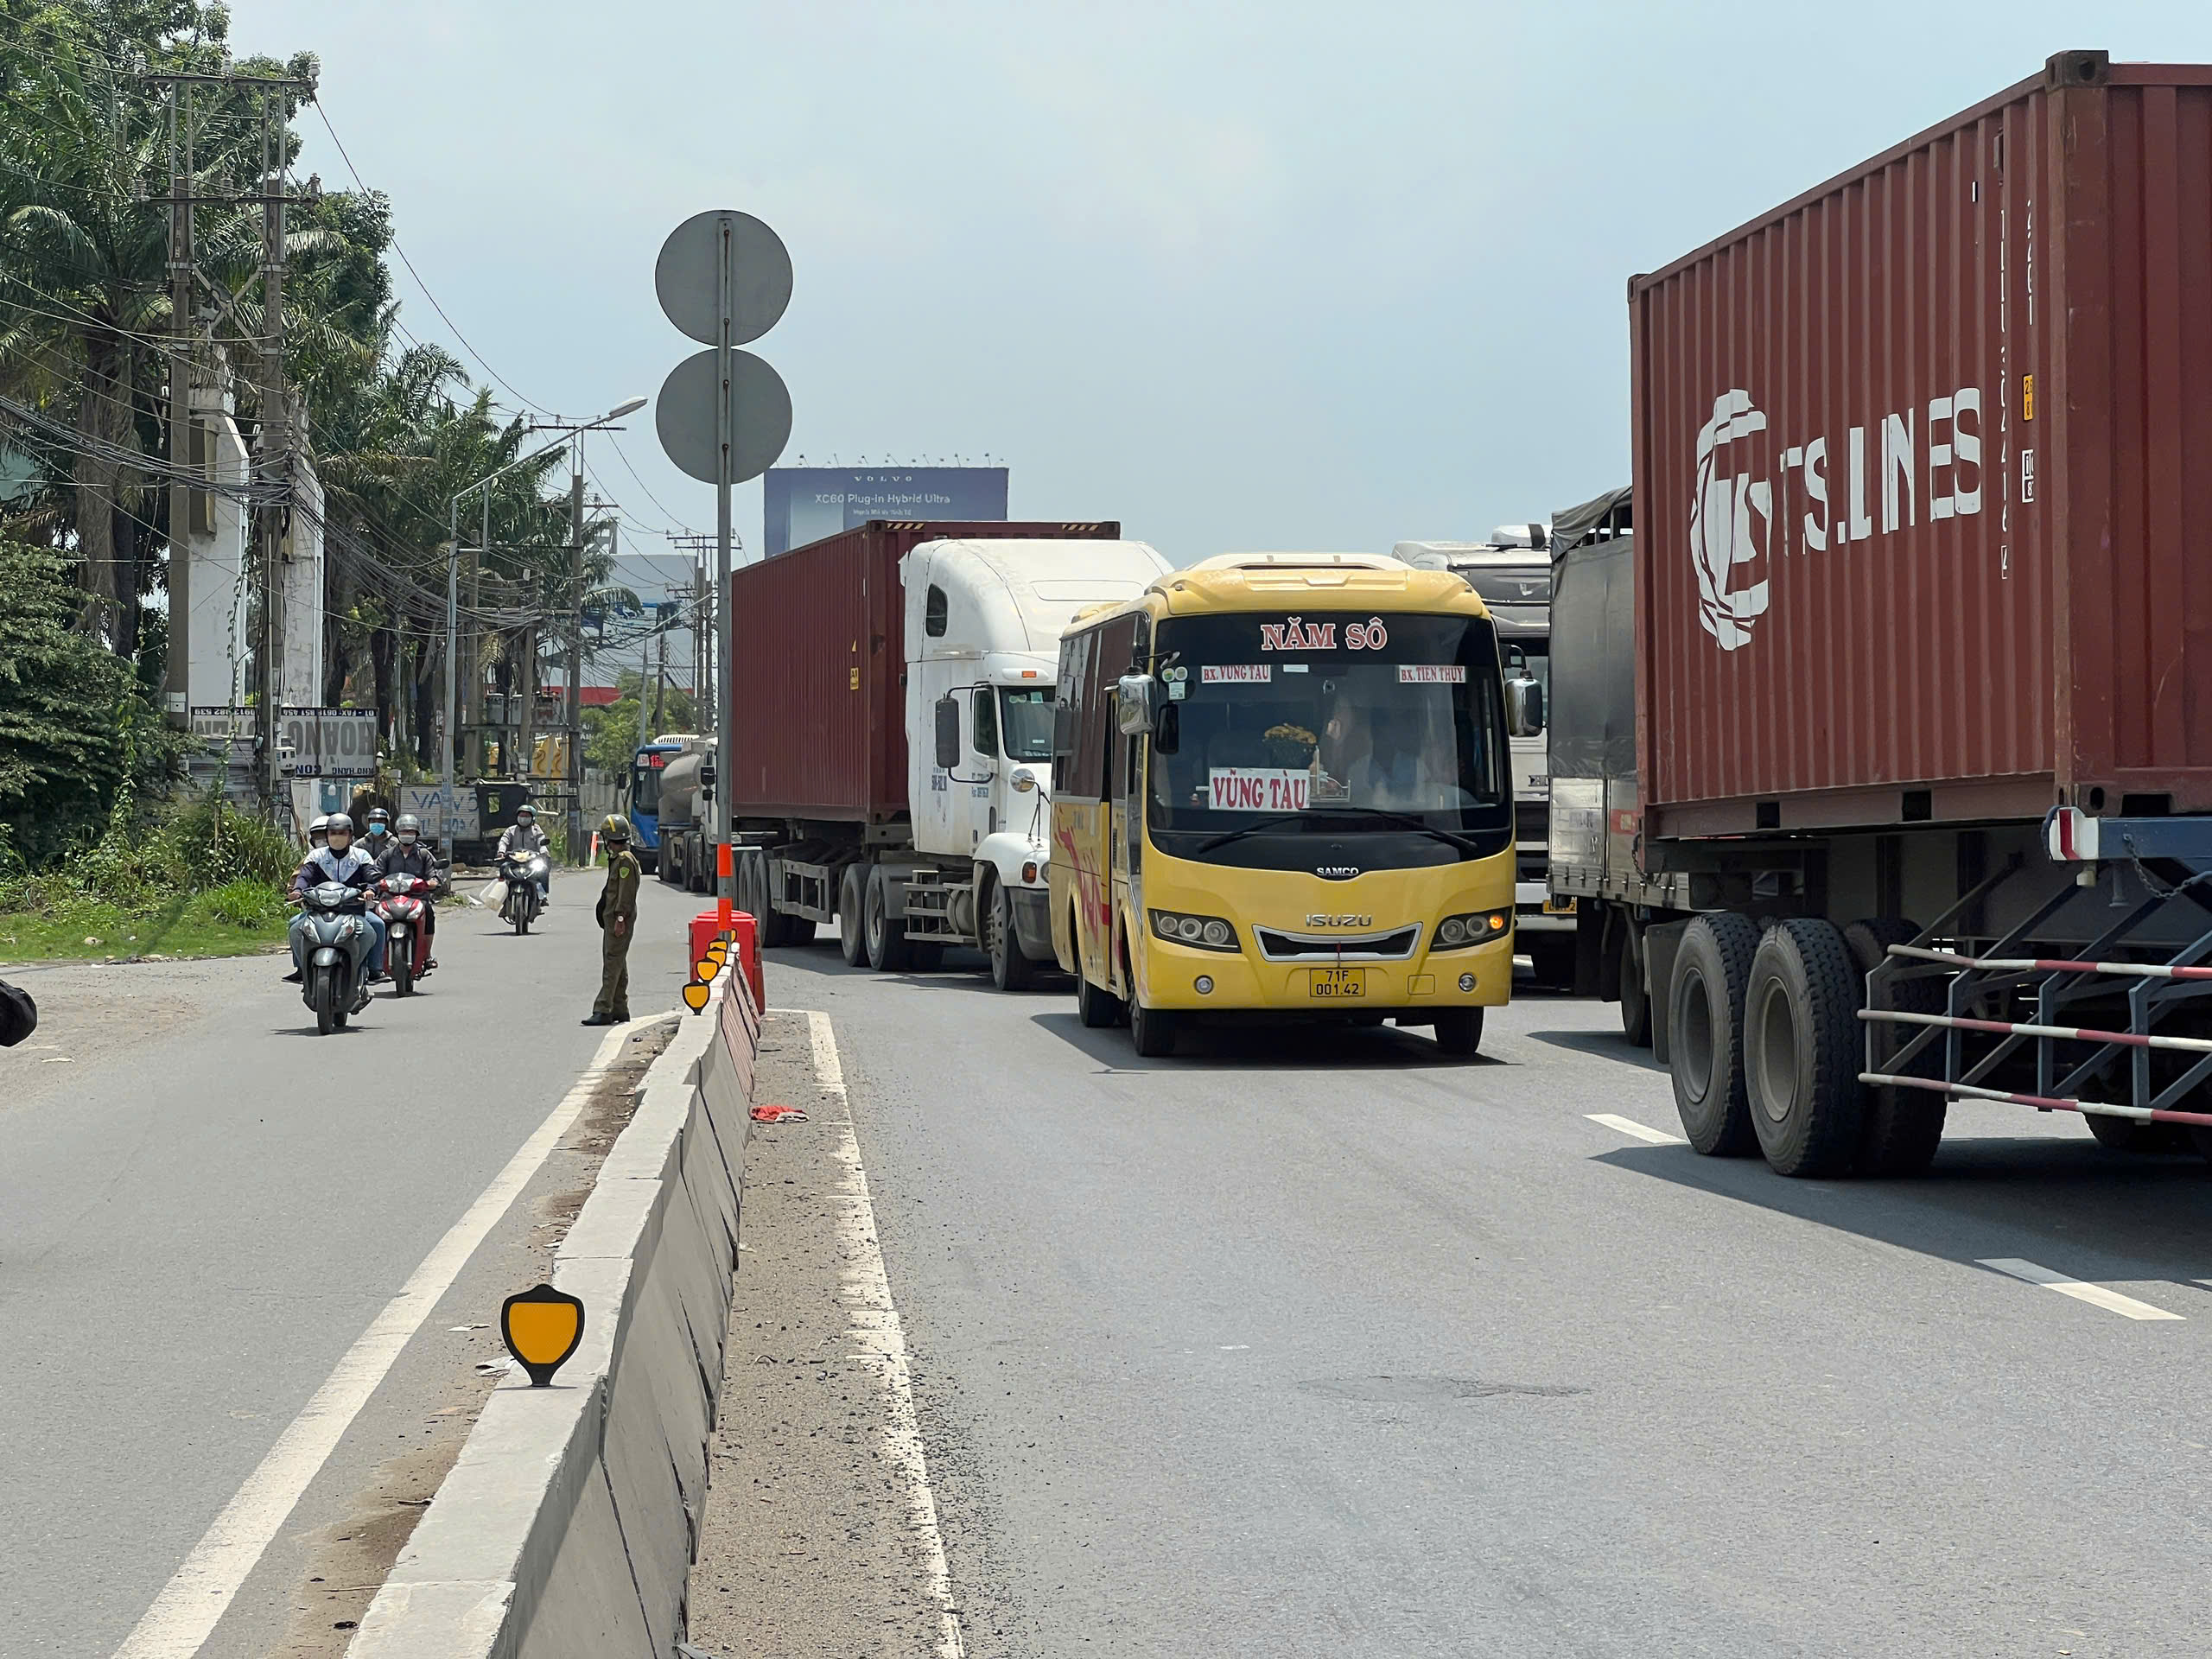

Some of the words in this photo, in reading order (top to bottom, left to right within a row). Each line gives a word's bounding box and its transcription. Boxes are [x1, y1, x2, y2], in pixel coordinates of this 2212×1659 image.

[815, 494, 844, 504] XC60
[848, 493, 885, 505] Plug-in
[887, 493, 922, 505] Hybrid
[925, 493, 951, 504] Ultra
[1261, 616, 1337, 651] NĂM
[1345, 616, 1388, 651] SÔ
[1204, 668, 1219, 681] BX.
[1401, 669, 1416, 681] BX.
[1213, 768, 1263, 808] VŨNG
[1269, 769, 1306, 809] TÀU
[1317, 868, 1359, 876] SAMCO
[1306, 914, 1371, 926] ISUZU
[1325, 970, 1349, 982] 71F
[1316, 983, 1359, 995] 001.42
